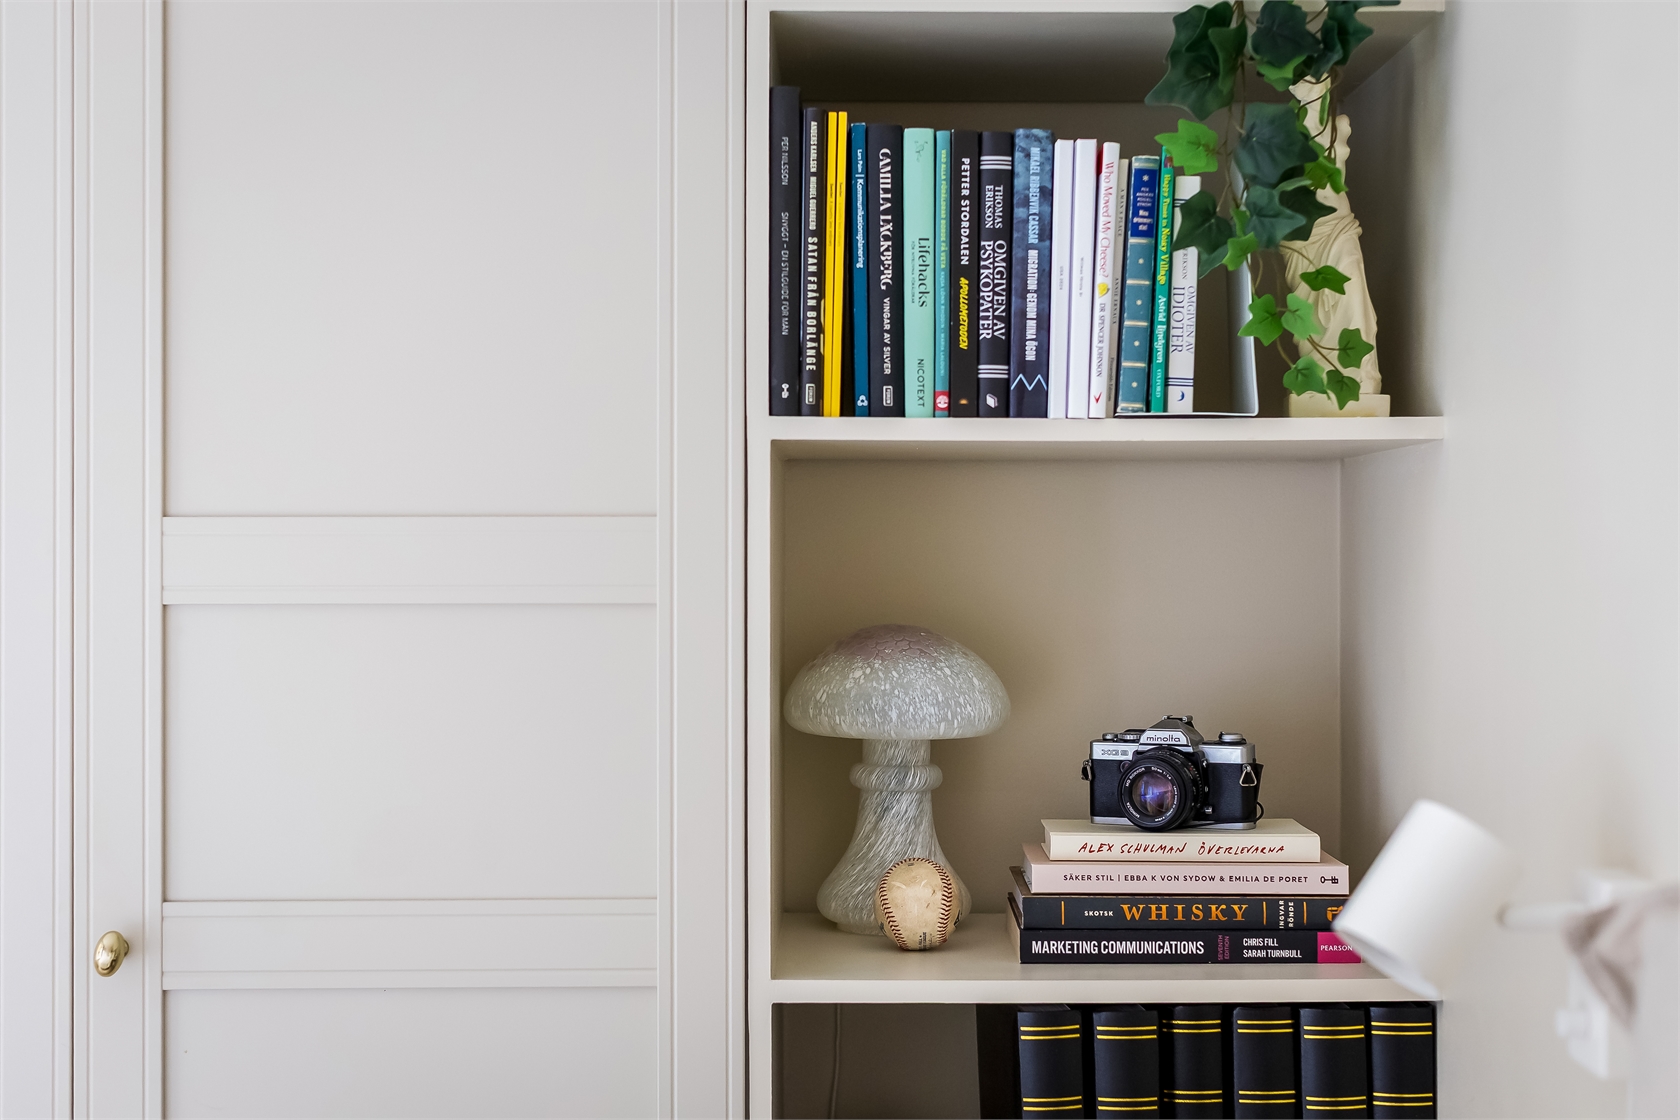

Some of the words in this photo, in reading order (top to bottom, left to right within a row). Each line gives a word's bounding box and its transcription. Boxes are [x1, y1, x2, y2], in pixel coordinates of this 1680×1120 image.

[1030, 147, 1040, 174] MIKAEL
[1104, 162, 1114, 184] Who
[879, 148, 891, 211] CAMILLA
[961, 158, 970, 195] PETTER
[985, 185, 994, 228] ERIKSON
[994, 185, 1003, 228] THOMAS
[1102, 186, 1113, 217] Moved
[856, 179, 864, 268] Kommunikationsplanering
[960, 200, 970, 264] STORDALEN
[1028, 216, 1039, 244] CASSAR
[1100, 220, 1111, 234] My
[808, 237, 818, 271] SATAN
[879, 215, 893, 290] LÄCKBERG
[1160, 228, 1170, 252] Noisy
[782, 250, 788, 260] EN
[1099, 237, 1111, 278] Cheese?
[1158, 254, 1169, 284] Village
[918, 238, 930, 308] Lifehacks
[994, 240, 1007, 319] OMGIVEN
[807, 277, 819, 306] FRÅN
[980, 240, 993, 340] PSYKOPATER
[959, 277, 969, 350] APOLLOMETODEN
[1026, 293, 1037, 318] GENOM
[1099, 303, 1106, 312] DR
[1157, 295, 1166, 321] Astrid
[1186, 286, 1196, 338] OMGIVEN
[994, 320, 1005, 340] AV
[1026, 320, 1036, 339] MINA
[1097, 315, 1105, 344] SPENCER
[1171, 287, 1185, 354] IDIOTER
[806, 311, 818, 371] BORLÄNGE
[883, 333, 890, 346] AV
[1025, 341, 1038, 361] ÖGON
[1154, 325, 1166, 363] Lindgren
[1186, 341, 1193, 354] AV
[1096, 345, 1104, 377] JOHNSON
[917, 358, 925, 407] NICOTEXT
[1078, 842, 1114, 853] ALEX
[1120, 842, 1187, 854] SCHULMAN
[1197, 842, 1285, 855] ÖVERLEVARNA
[1063, 873, 1092, 881] SÄKER
[1120, 903, 1248, 921] WHISKY
[1031, 941, 1098, 954] MARKETING
[1101, 941, 1204, 955] COMMUNICATIONS
[1243, 938, 1263, 947] CHRIS
[1265, 938, 1278, 947] FILL
[1243, 950, 1266, 958] SARAH
[1268, 950, 1302, 958] TURNBULL
